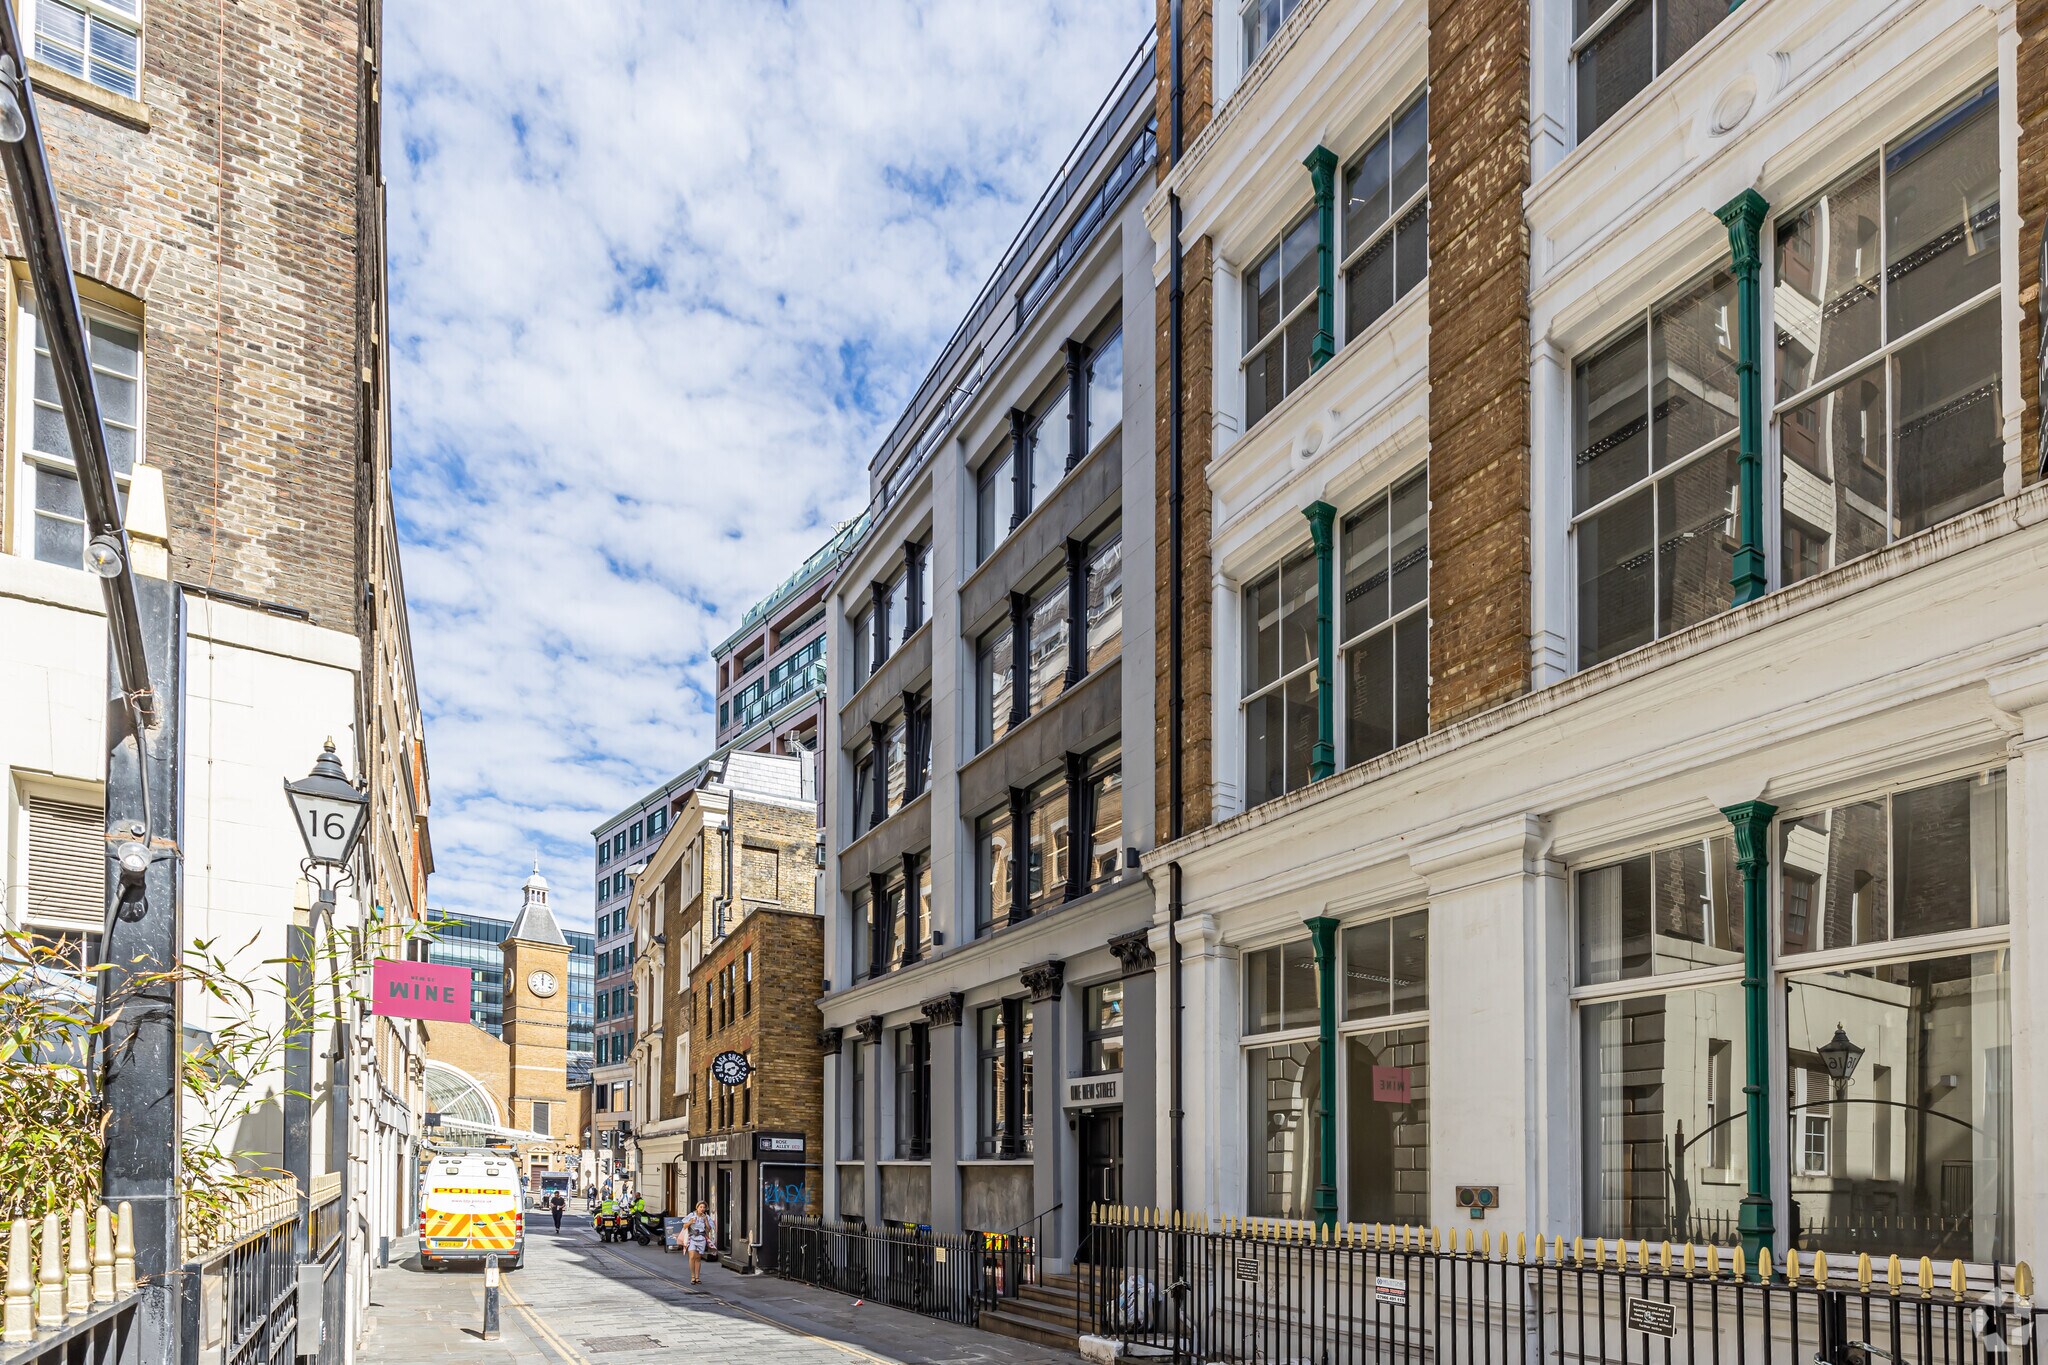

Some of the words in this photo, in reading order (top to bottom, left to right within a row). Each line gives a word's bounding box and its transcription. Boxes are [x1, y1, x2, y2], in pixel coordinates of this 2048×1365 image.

[309, 810, 345, 840] 16
[390, 982, 454, 1004] WINE
[715, 1054, 728, 1072] BLACK
[728, 1054, 746, 1066] SHEEP
[724, 1071, 746, 1084] COFFEE
[1082, 1084, 1094, 1100] NEW
[1096, 1081, 1116, 1098] STREET
